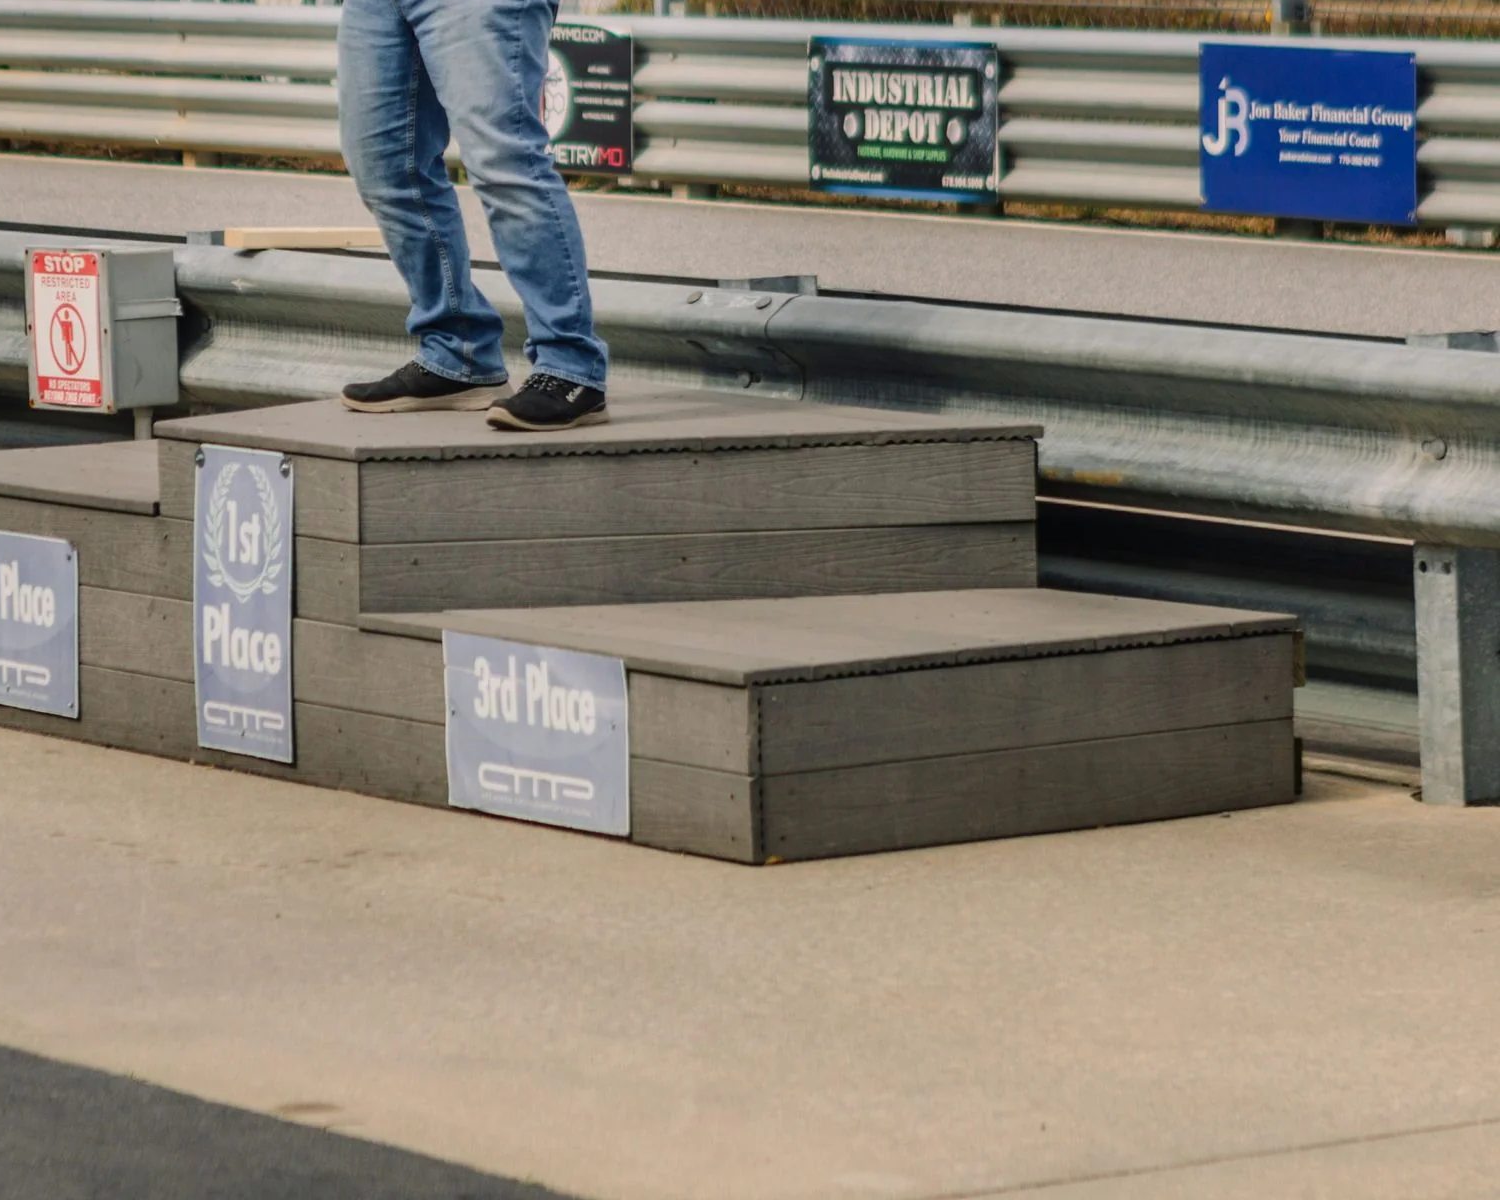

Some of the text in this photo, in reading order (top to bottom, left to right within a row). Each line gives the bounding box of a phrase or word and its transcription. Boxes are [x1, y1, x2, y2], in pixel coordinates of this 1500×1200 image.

[832, 69, 974, 108] INDUSTRIAL
[863, 108, 940, 144] DEPOT
[1249, 101, 1412, 131] Jon Baker Financial Group
[1278, 128, 1380, 148] Your Financial Coach
[44, 255, 85, 273] STOP
[41, 276, 90, 289] RESTRICTED
[55, 291, 76, 301] AREA
[226, 500, 262, 566] 1st
[0, 559, 56, 628] Place
[202, 604, 282, 675] Place
[473, 655, 596, 735] 3rd Place
